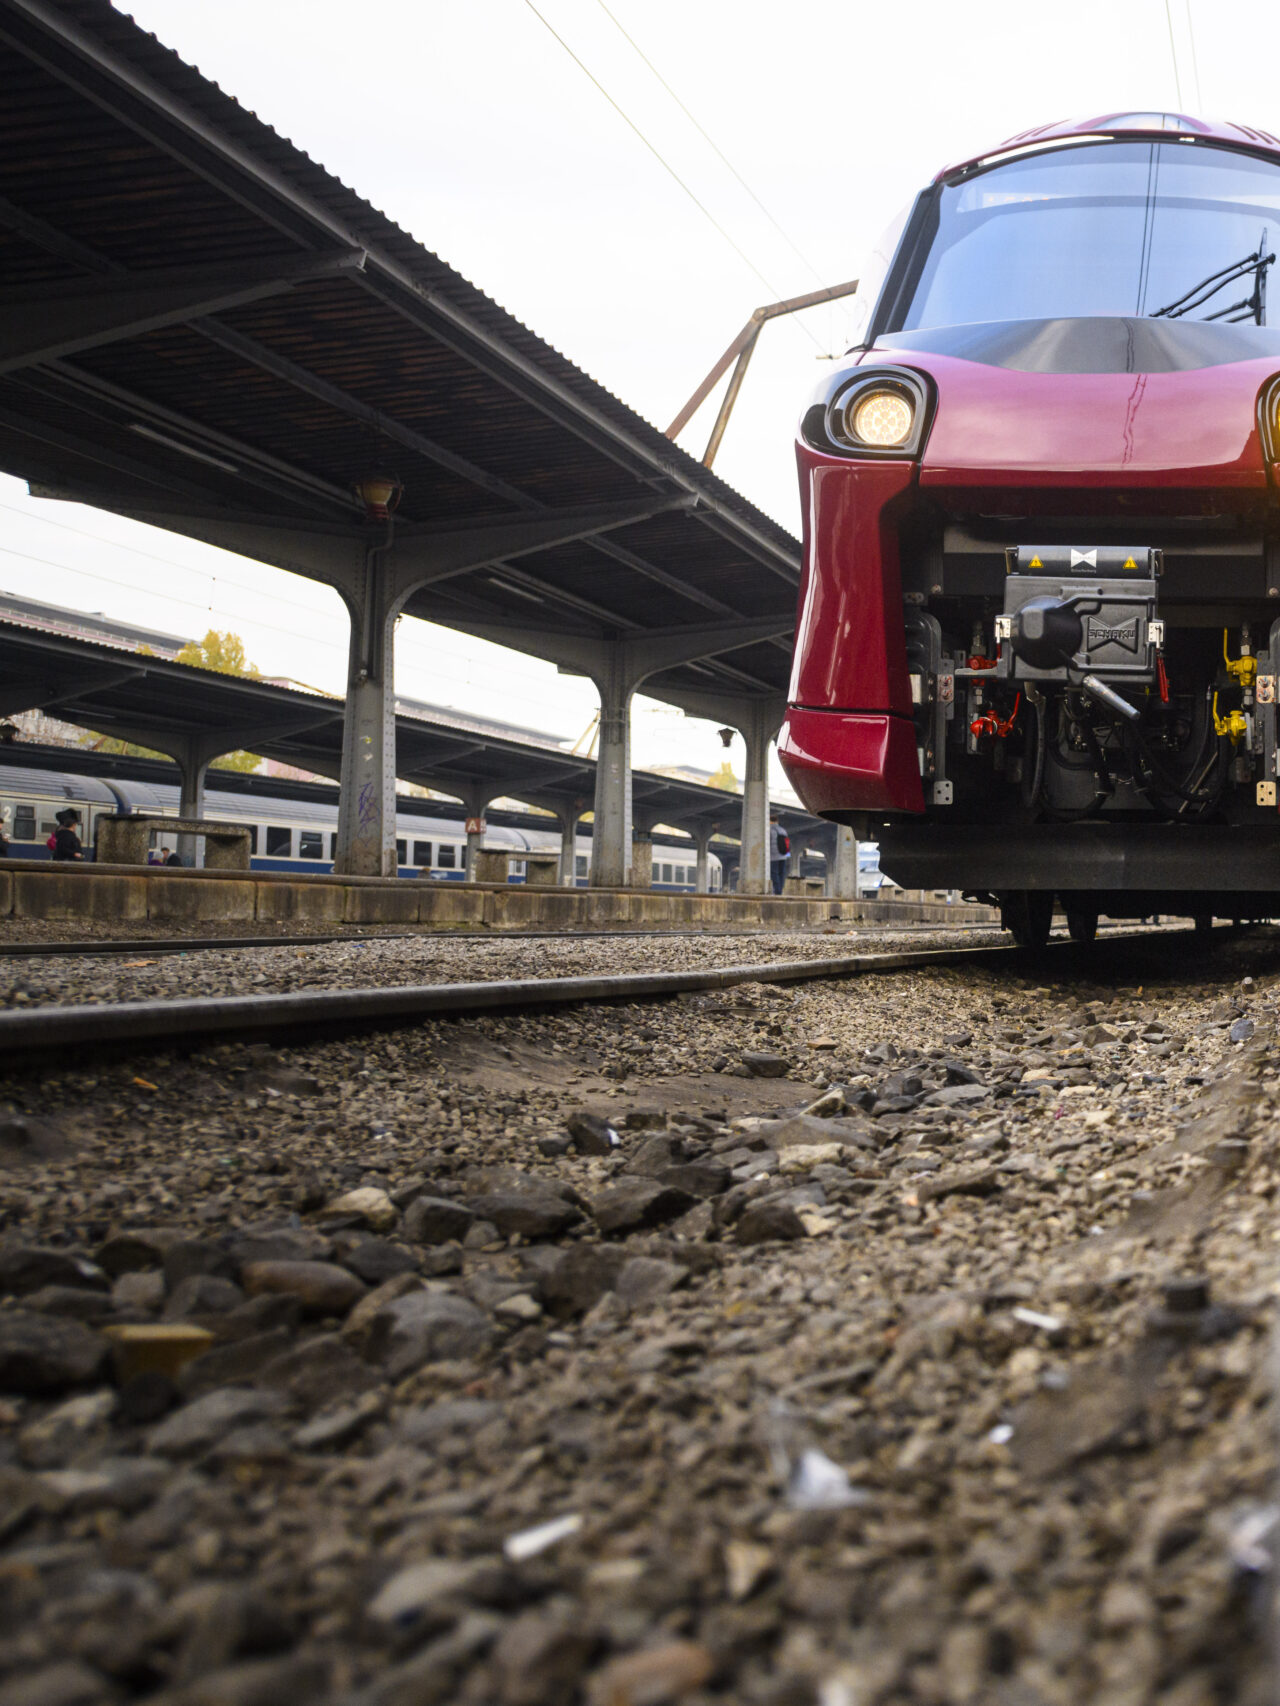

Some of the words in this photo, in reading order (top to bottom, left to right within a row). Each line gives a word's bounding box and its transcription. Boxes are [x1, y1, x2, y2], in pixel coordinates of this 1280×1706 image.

[1088, 629, 1136, 638] SCHAKU
[4, 806, 12, 822] 2
[467, 820, 478, 832] A
